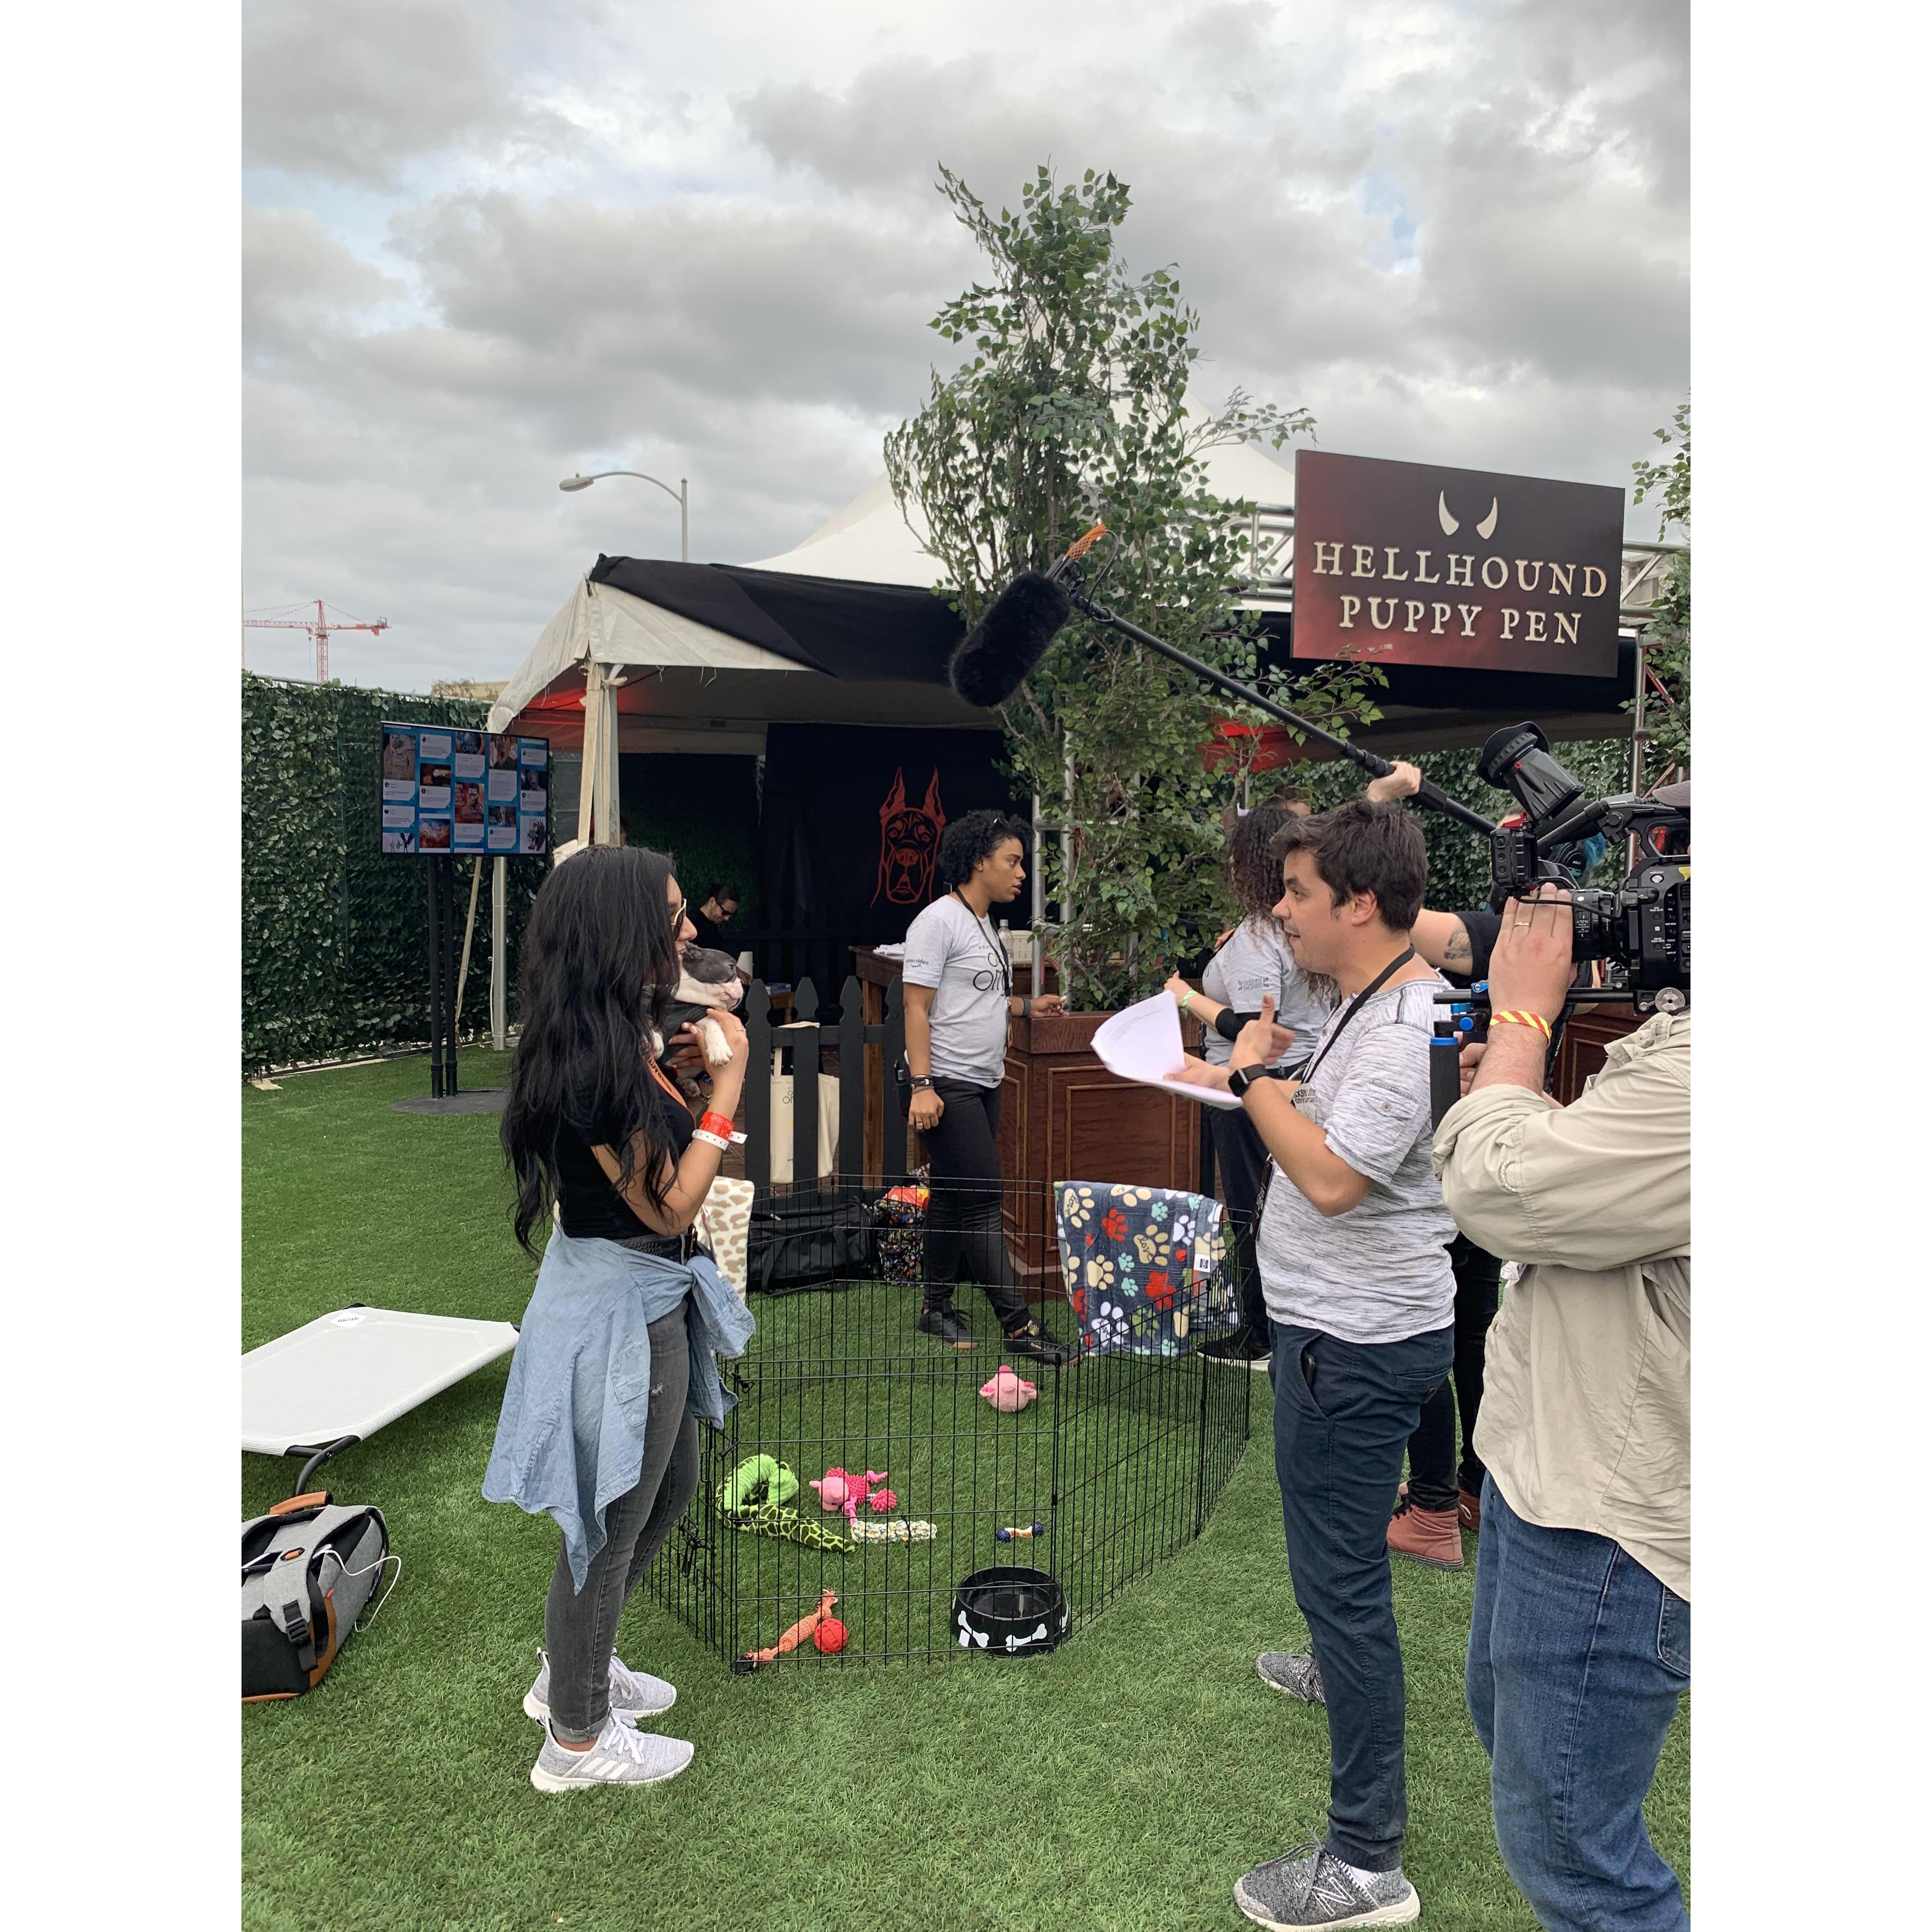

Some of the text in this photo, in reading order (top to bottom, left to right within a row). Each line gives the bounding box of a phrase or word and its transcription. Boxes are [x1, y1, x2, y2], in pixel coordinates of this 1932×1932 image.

[1312, 541, 1607, 598] HELLHOUND
[1339, 595, 1582, 644] PUPPY PEN
[1064, 1193, 1079, 1215] love
[1137, 1237, 1153, 1262] love
